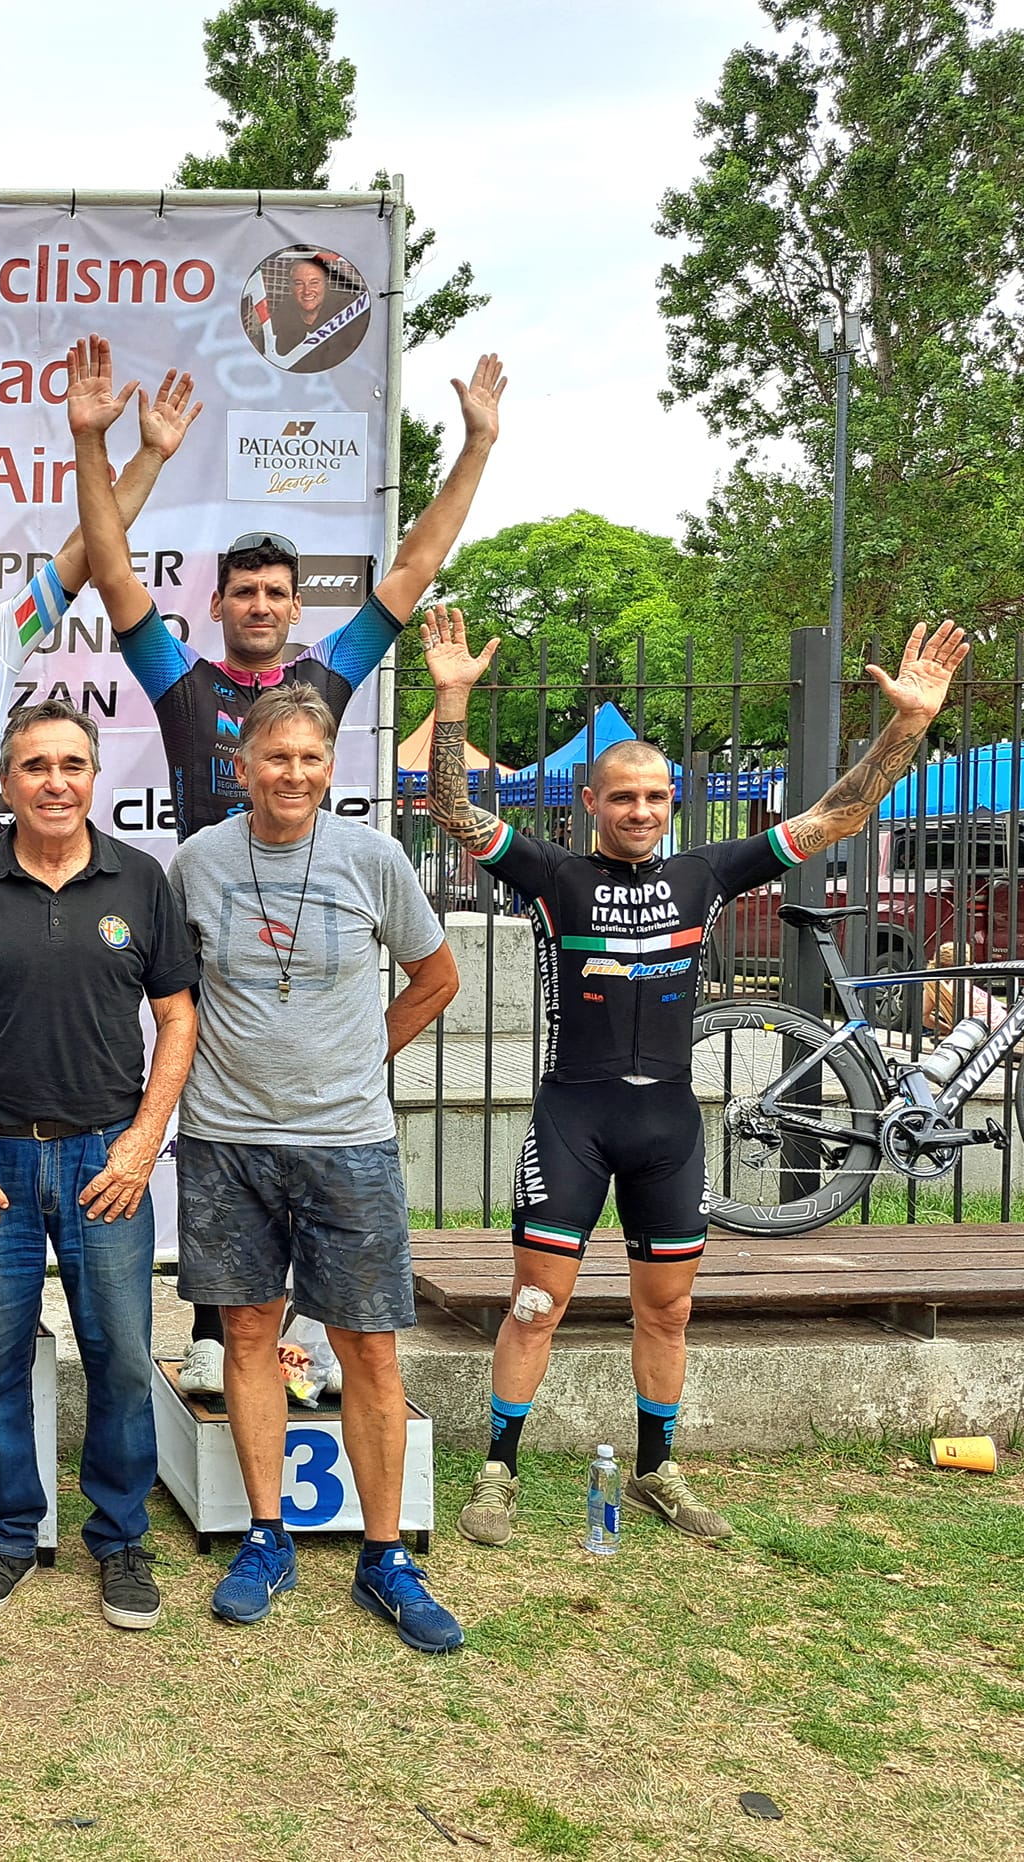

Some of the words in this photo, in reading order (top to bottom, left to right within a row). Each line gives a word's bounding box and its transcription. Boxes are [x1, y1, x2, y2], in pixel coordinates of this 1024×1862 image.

[303, 294, 367, 345] DAZZAN
[238, 437, 360, 457] PATAGONIA
[254, 457, 341, 470] FLOORING
[594, 880, 672, 905] GRUPO
[591, 902, 680, 924] ITALIANA
[629, 926, 634, 934] y
[942, 1006, 1024, 1116] S-WORKS
[280, 1428, 345, 1527] 3
